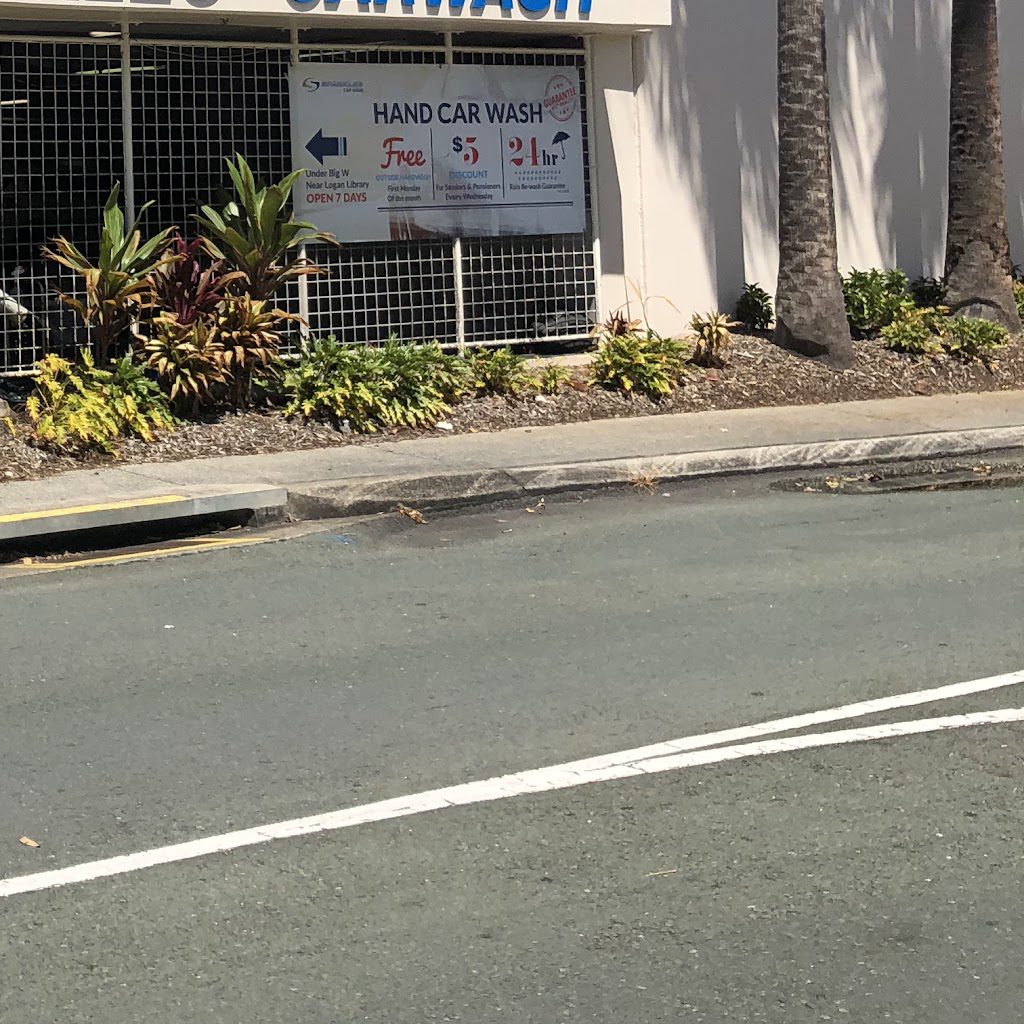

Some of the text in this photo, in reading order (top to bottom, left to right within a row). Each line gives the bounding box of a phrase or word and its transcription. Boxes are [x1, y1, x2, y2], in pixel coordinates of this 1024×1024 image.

[543, 86, 577, 108] GUARANTEE
[373, 102, 543, 125] HAND CAR WASH
[380, 137, 426, 169] Free
[306, 169, 350, 179] Under Big W
[448, 170, 489, 180] DISCOUNT
[306, 180, 369, 190] Near Logan Library
[306, 192, 367, 204] OPEN 7 DAYS
